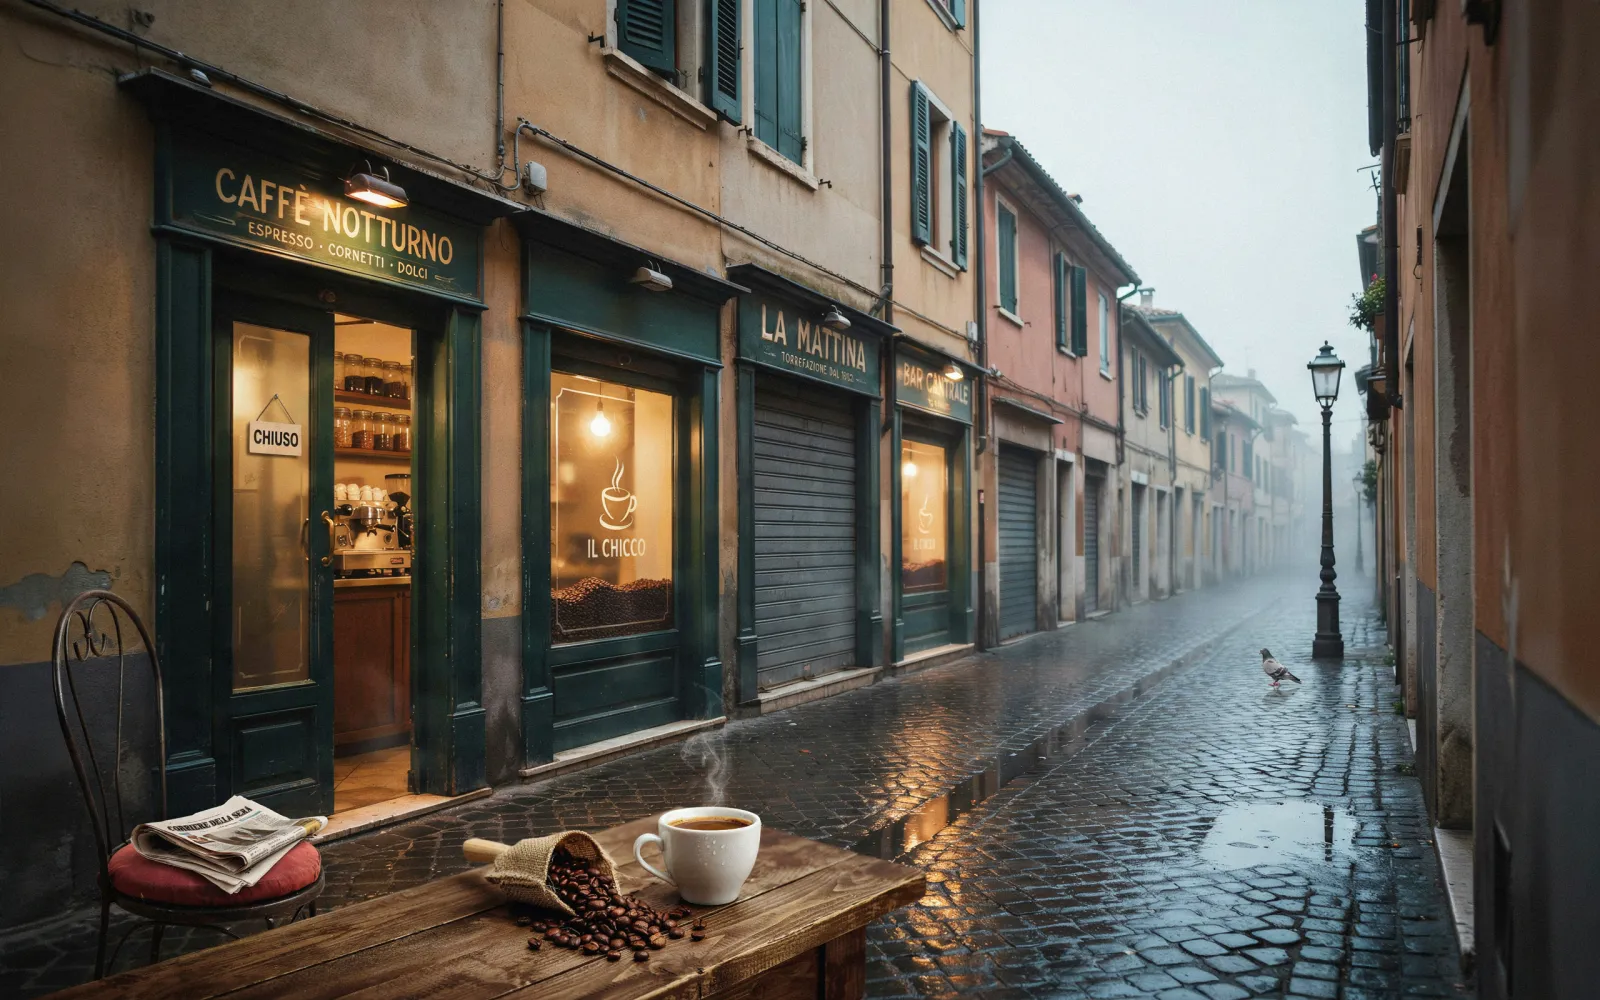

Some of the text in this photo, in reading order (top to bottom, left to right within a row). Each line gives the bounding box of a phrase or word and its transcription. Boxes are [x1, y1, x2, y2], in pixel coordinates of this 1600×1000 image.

[215, 167, 453, 265] CAFFÈ NOTTURNO
[248, 221, 428, 280] ESPRESSO CORNETTI DOLCI
[761, 304, 866, 373] LA MATTINA
[781, 351, 827, 375] TORREFAZIONE
[829, 366, 840, 379] DAL
[903, 362, 923, 390] BAR
[253, 429, 299, 447] CHIUSO
[588, 538, 646, 558] IL CHICCO
[167, 821, 211, 832] CORRIERE
[231, 805, 253, 818] SERA
